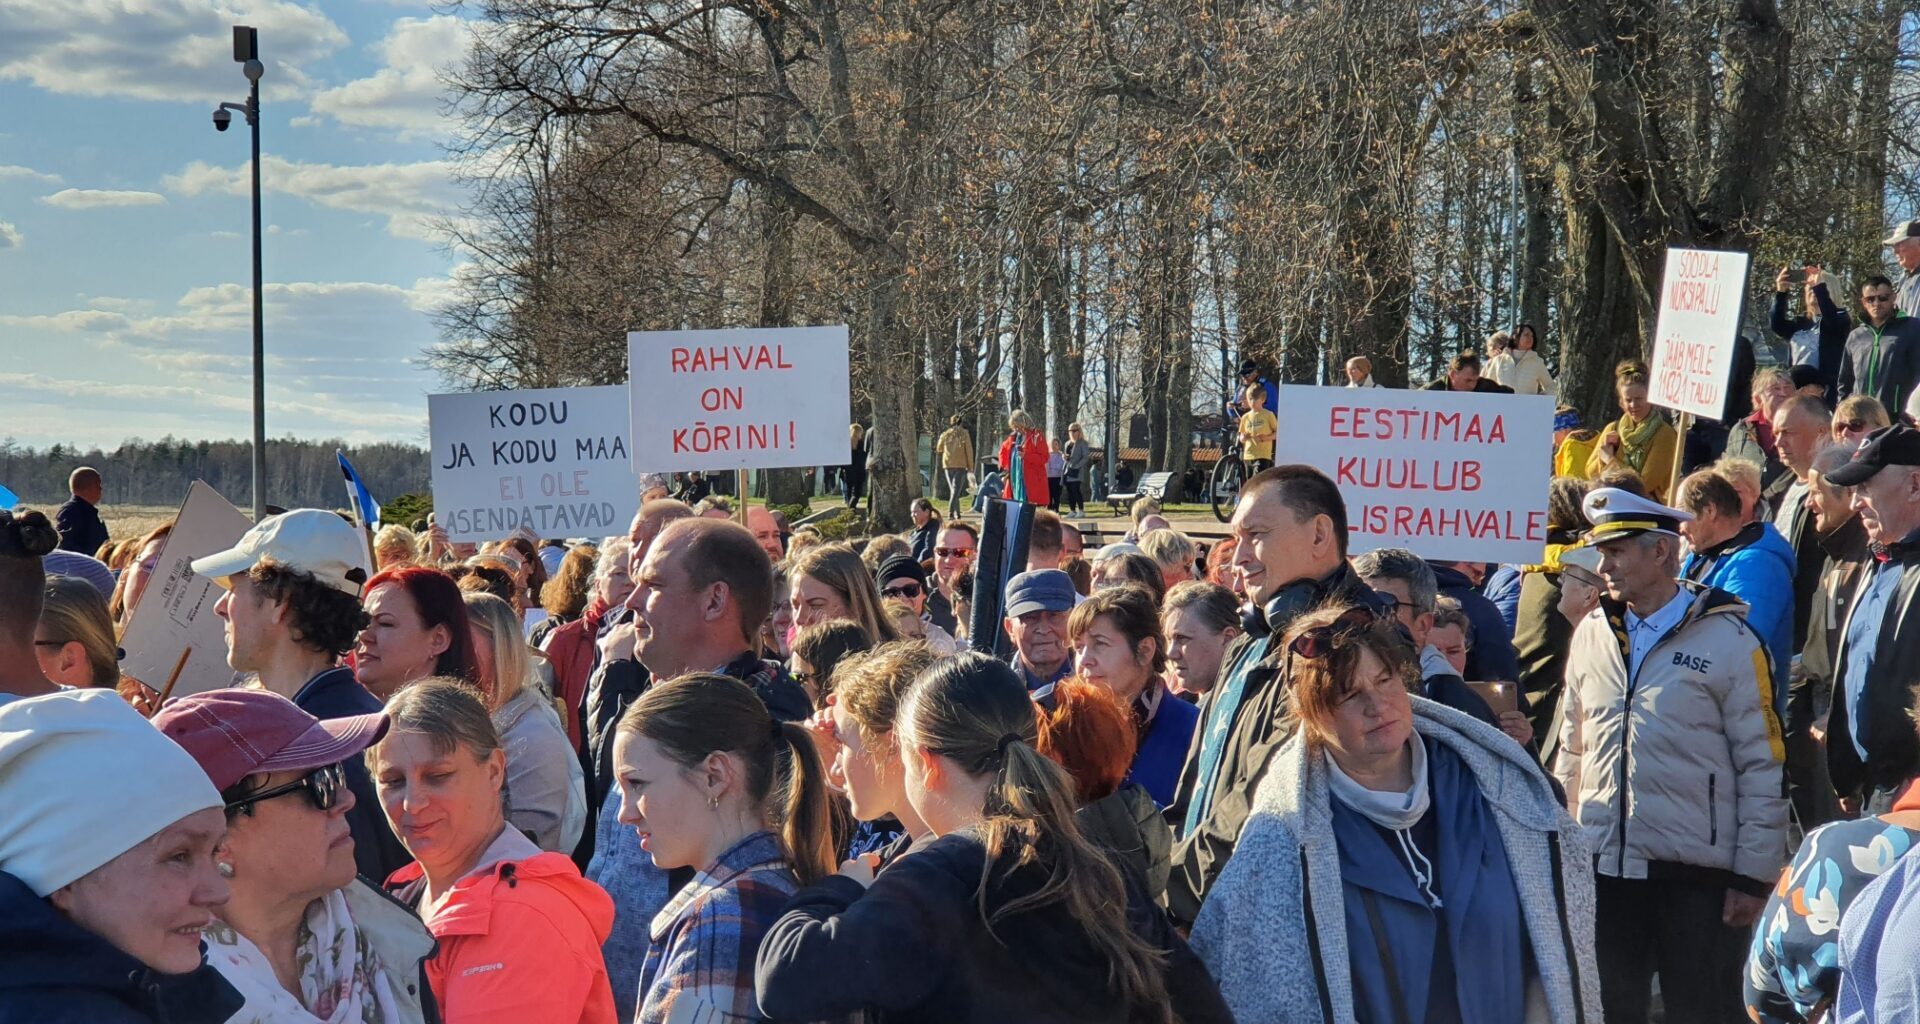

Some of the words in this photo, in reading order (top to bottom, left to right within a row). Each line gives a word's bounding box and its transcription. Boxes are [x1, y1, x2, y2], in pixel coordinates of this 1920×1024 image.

[672, 344, 793, 373] RAHVAL
[489, 400, 568, 429] KODU
[701, 386, 743, 412] ON
[1330, 407, 1505, 443] EESTIMAA
[442, 443, 475, 470] JA
[492, 438, 557, 466] KODU
[576, 435, 627, 461] MAA
[500, 475, 524, 501] EI
[540, 470, 590, 497] OLE
[1336, 456, 1482, 492] KUULUB
[445, 501, 616, 535] ASENDATAVAD
[1672, 651, 1712, 674] BASE
